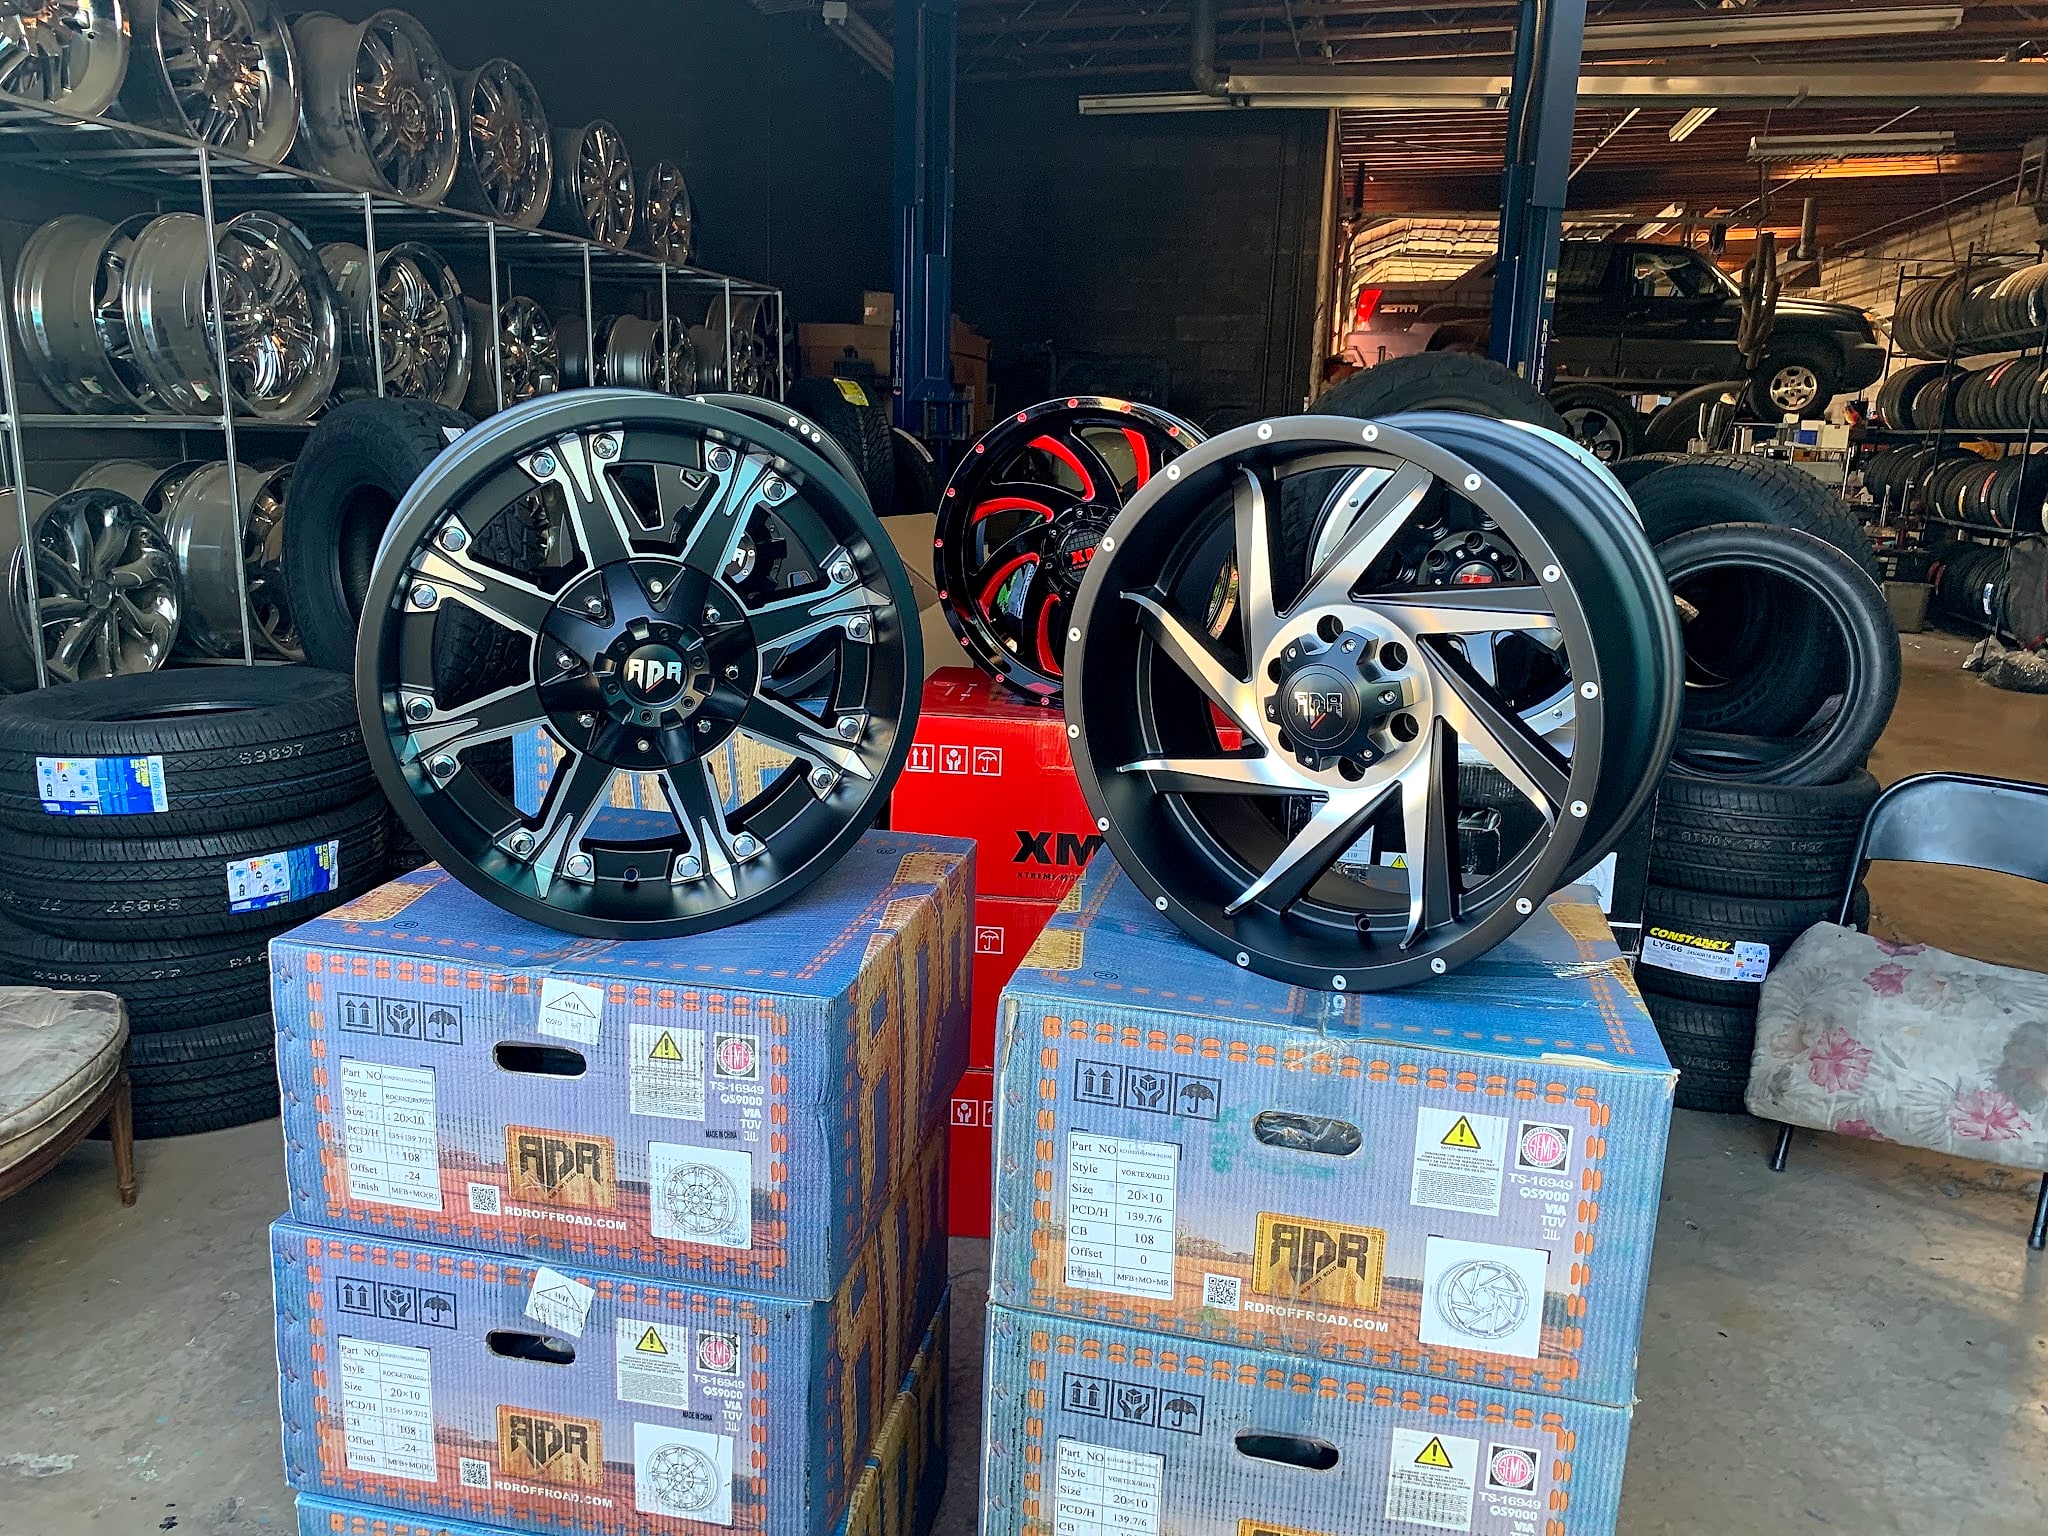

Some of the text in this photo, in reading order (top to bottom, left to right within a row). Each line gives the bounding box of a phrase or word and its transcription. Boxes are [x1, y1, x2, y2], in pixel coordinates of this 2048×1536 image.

[1536, 318, 1549, 393] ROTARY
[1012, 830, 1102, 866] XM
[1649, 927, 1732, 951] CONSTANCY
[343, 1067, 361, 1078] Part
[366, 1070, 382, 1081] NO
[344, 1087, 367, 1098] Style
[709, 1081, 765, 1095] TS-16949
[720, 1094, 763, 1106] QS9000
[346, 1105, 365, 1117] Size
[347, 1125, 379, 1137] PCD/H
[705, 1130, 738, 1139] MADE IN CHINA
[348, 1144, 421, 1162] CB 108
[1072, 1140, 1092, 1151] Part
[1098, 1144, 1117, 1155] NO
[1529, 1134, 1559, 1161] SEMA
[350, 1162, 421, 1181] Offset -24
[1072, 1161, 1098, 1174] Style
[352, 1180, 379, 1192] Finish
[1072, 1182, 1094, 1195] Size
[1508, 1173, 1574, 1190] TS-16949
[1520, 1187, 1570, 1202] QS9000
[1072, 1204, 1162, 1224] PCD/H 139.7/6
[1544, 1203, 1567, 1216] VIA
[504, 1206, 627, 1231] RDROFFROAD.COM
[1071, 1226, 1154, 1245] CB 108
[1071, 1246, 1103, 1259] Offset
[1070, 1265, 1169, 1286] Finish MFB+MO+MR
[1244, 1300, 1389, 1333] RDROFFROAD.COM
[341, 1345, 358, 1355] Part
[363, 1348, 379, 1358] NO
[343, 1363, 365, 1375] Style
[344, 1381, 363, 1391] Size
[692, 1373, 745, 1389] TS-16949
[345, 1399, 376, 1411] PCD/H
[700, 1413, 713, 1421] CHINA
[346, 1417, 416, 1435] CB 108
[347, 1435, 416, 1453] Offset -24
[349, 1452, 376, 1463] Finish
[1060, 1446, 1104, 1462] Part NO
[1060, 1466, 1086, 1478] Style
[1497, 1456, 1529, 1483] SEMA
[494, 1480, 613, 1508] RDROFFROAD.COM
[1060, 1485, 1081, 1496] Size
[1478, 1491, 1542, 1510] TS-16949
[1059, 1504, 1147, 1527] PCD/H 139.7/6
[1490, 1506, 1538, 1521] QS9000
[1058, 1522, 1075, 1532] CB
[1513, 1521, 1536, 1534] VIA
